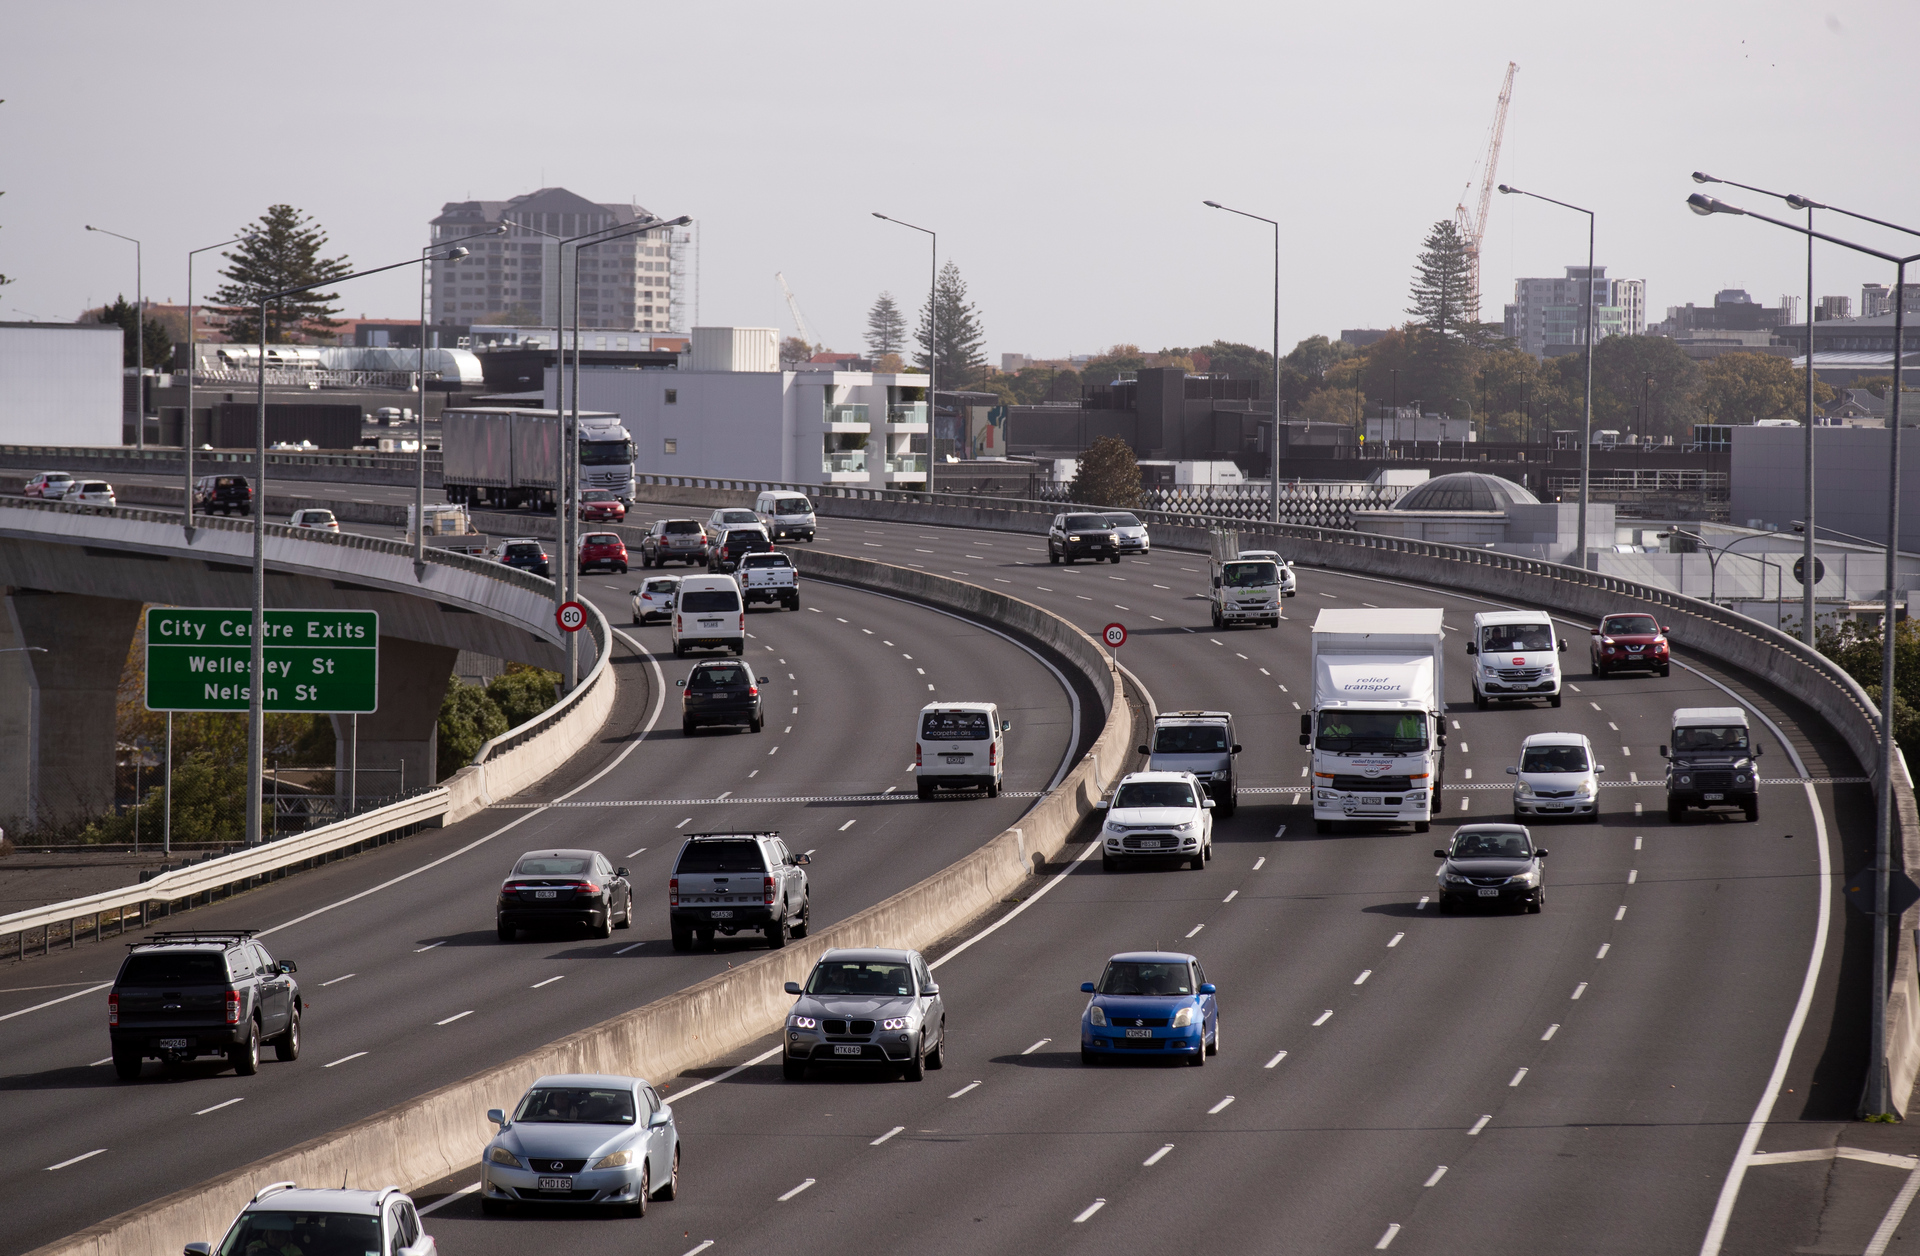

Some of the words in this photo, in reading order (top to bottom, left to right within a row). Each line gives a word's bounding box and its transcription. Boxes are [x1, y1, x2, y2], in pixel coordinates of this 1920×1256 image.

[563, 611, 580, 623] 80
[160, 620, 206, 640] City
[220, 620, 294, 637] Cetre
[307, 622, 365, 638] Exits
[1108, 630, 1122, 640] 80
[312, 658, 335, 675] St
[204, 683, 278, 700] Nelsn
[295, 685, 318, 701] St
[1343, 684, 1402, 692] transport
[681, 896, 763, 904] RANGER
[835, 1046, 861, 1054] HTK849
[539, 1178, 572, 1189] KHD185
